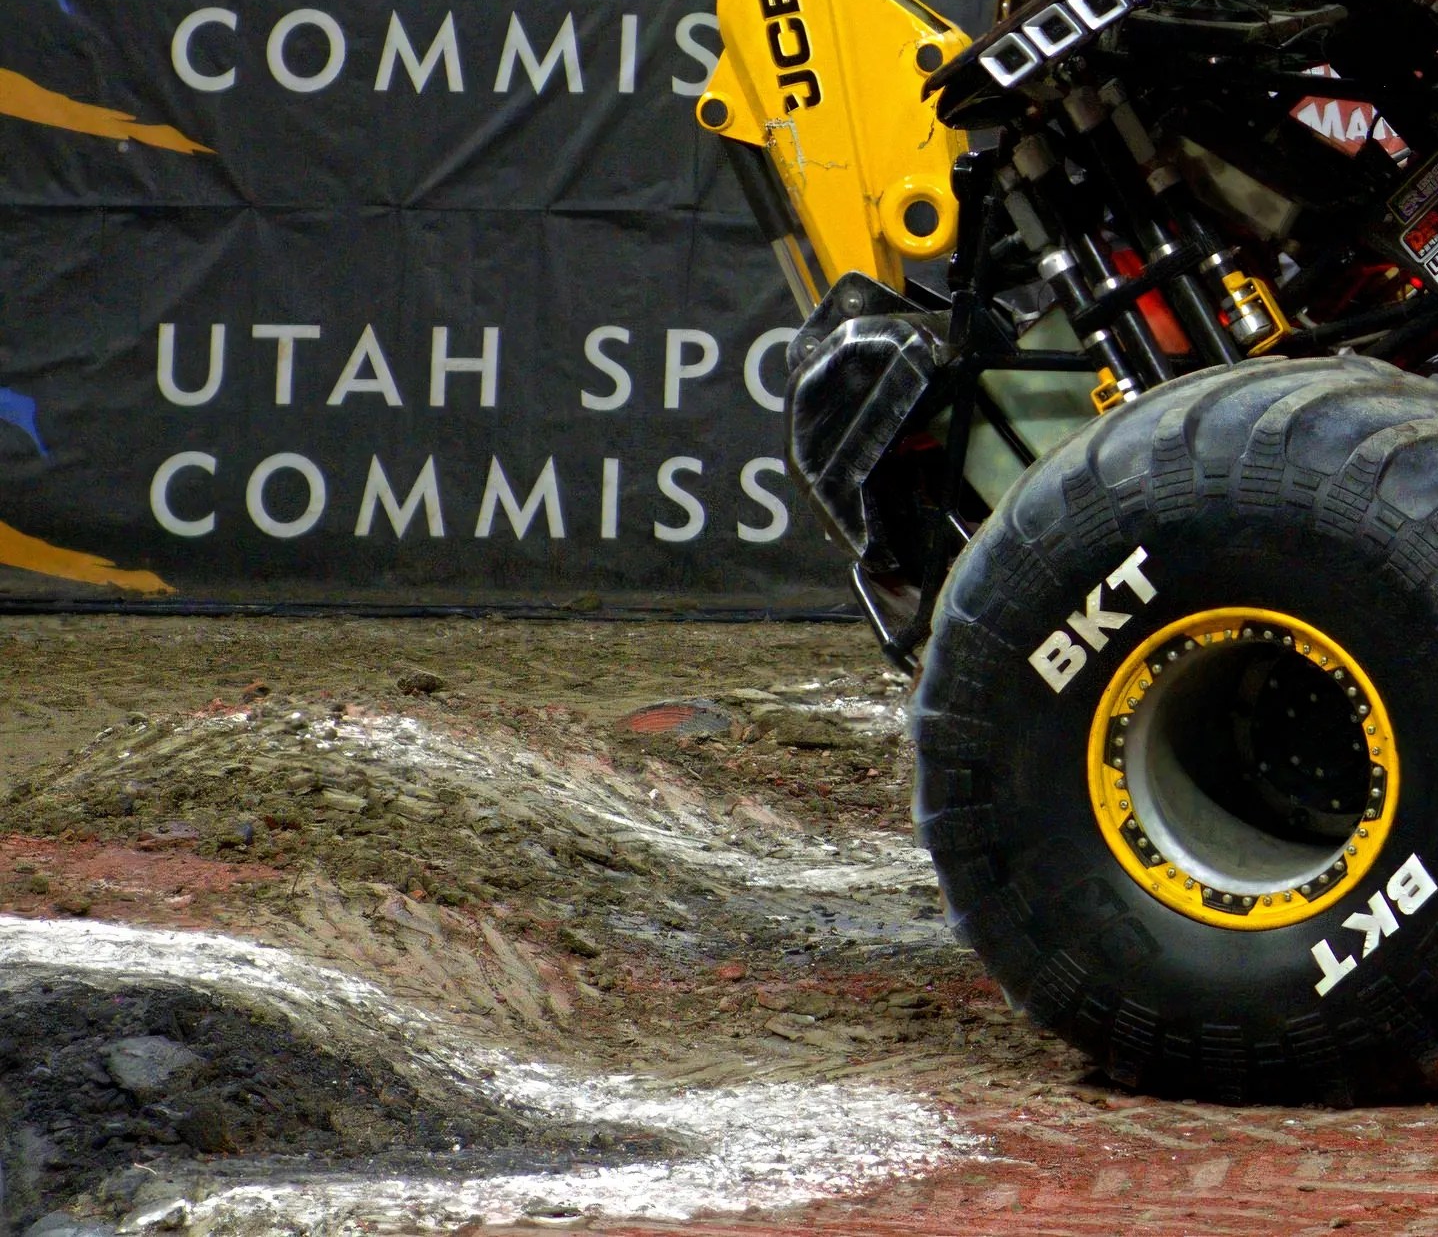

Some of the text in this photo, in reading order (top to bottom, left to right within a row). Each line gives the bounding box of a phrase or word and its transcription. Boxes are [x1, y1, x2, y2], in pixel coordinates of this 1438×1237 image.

[172, 7, 720, 98] COMMIS
[156, 322, 500, 408] UTAH
[1027, 546, 1158, 694] BKT
